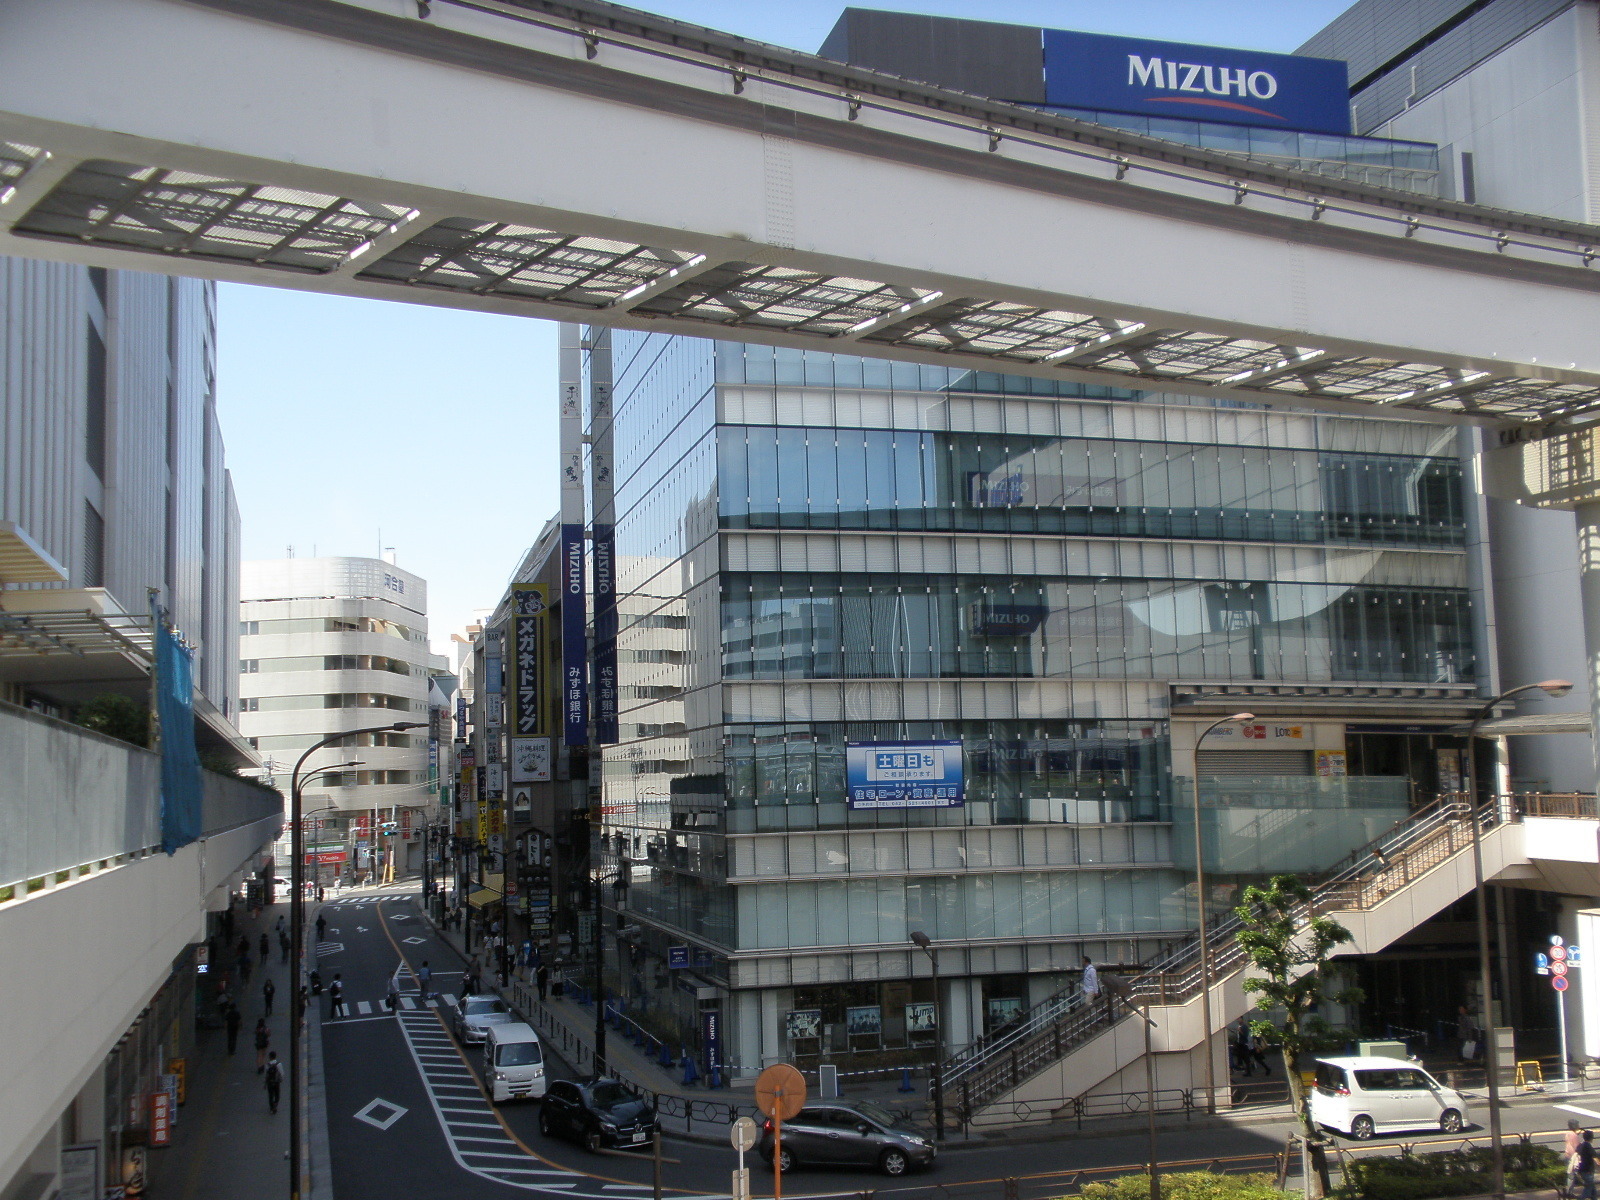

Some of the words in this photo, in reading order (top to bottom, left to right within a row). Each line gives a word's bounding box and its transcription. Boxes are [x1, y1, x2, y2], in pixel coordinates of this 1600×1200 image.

[1127, 54, 1278, 99] MIZUHO
[569, 542, 581, 594] MIZUHO
[487, 633, 499, 642] BAR
[518, 620, 537, 733] メガネドラッグ
[569, 666, 581, 723] みずほ銀行
[878, 754, 934, 768] 土曜日も
[855, 787, 957, 800] 住宅ローン・資産運用
